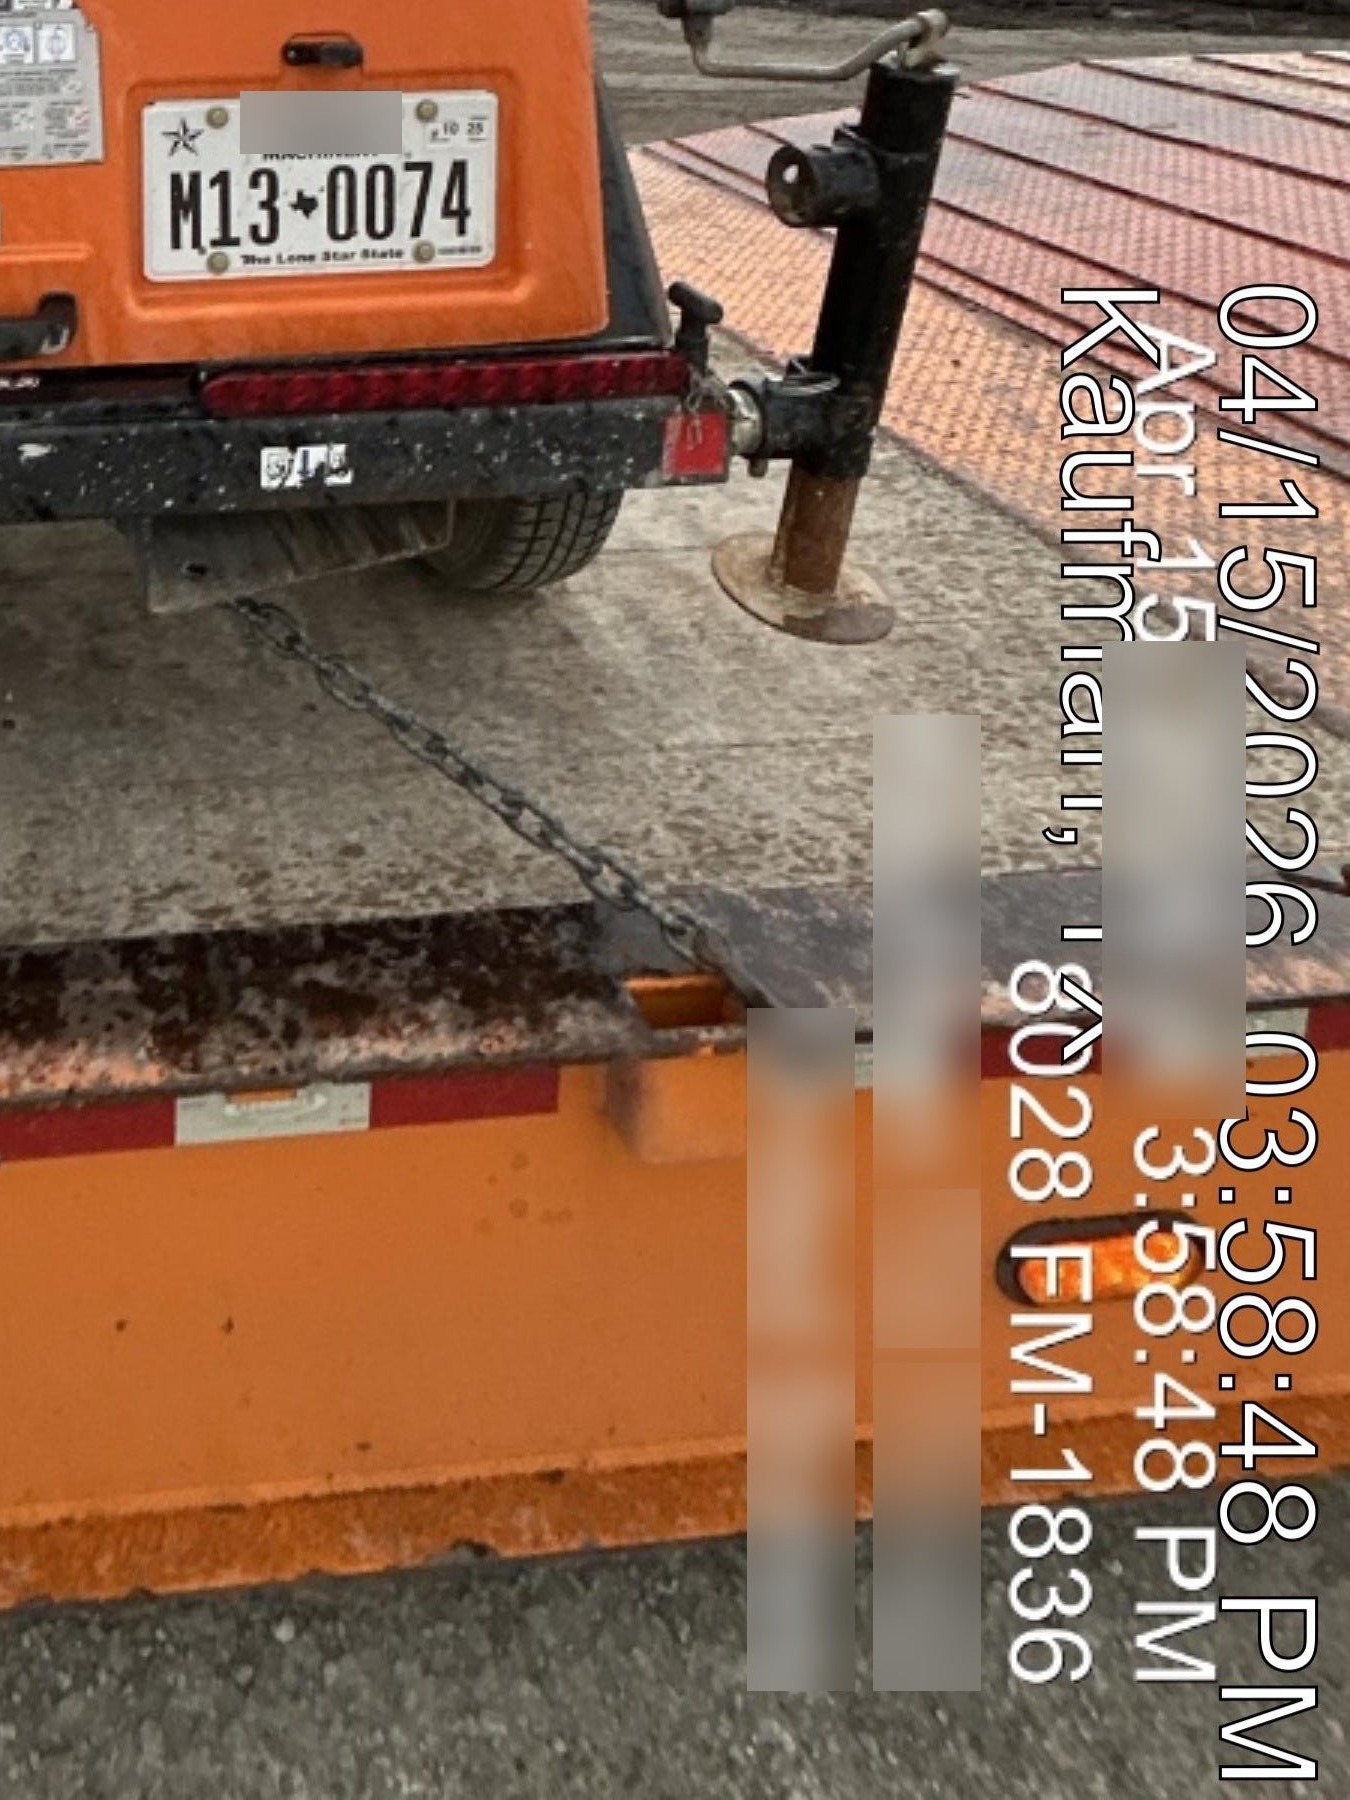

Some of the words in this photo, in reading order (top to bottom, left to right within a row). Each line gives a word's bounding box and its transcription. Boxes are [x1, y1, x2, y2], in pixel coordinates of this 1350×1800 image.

[276, 252, 317, 265] Lone
[321, 250, 357, 262] Star
[360, 248, 405, 260] State
